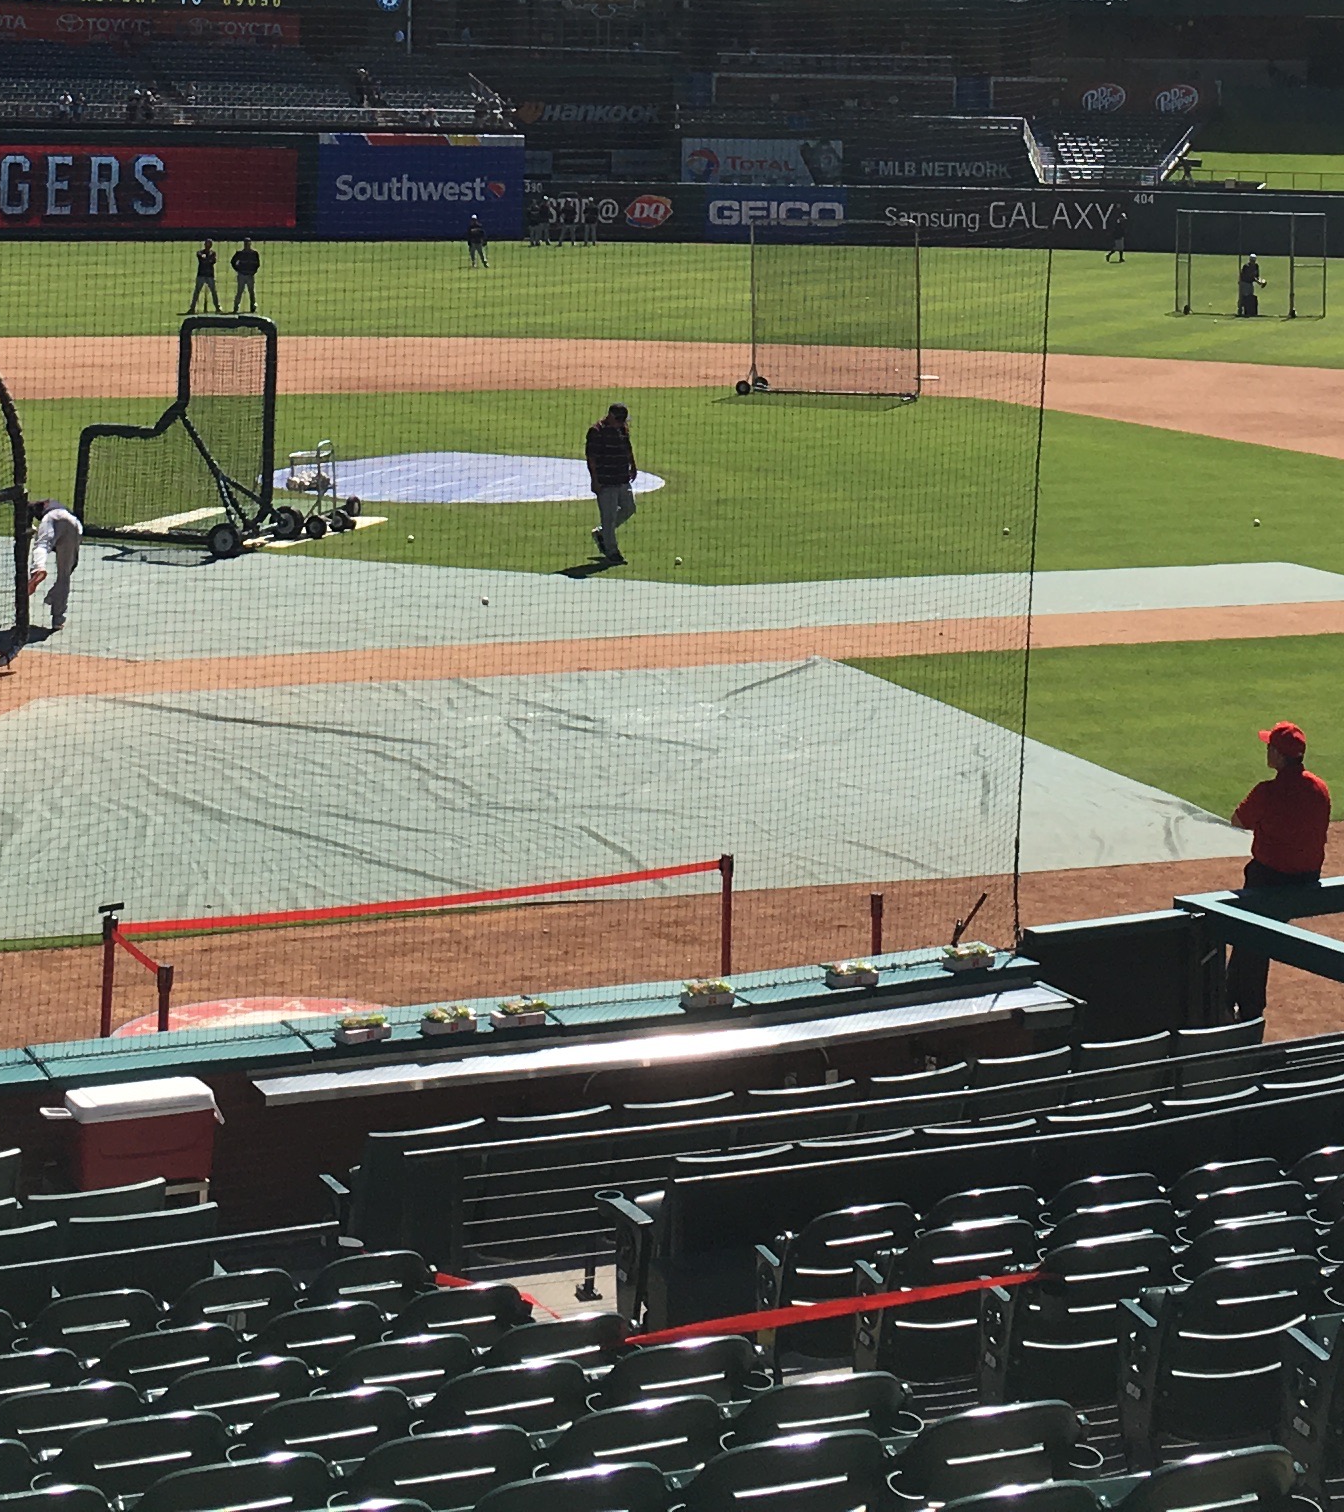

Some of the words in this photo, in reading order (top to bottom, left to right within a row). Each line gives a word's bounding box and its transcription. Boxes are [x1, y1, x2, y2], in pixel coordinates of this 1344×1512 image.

[878, 161, 917, 177] MLB
[921, 161, 1011, 178] NETWORK
[336, 174, 486, 203] Southwest
[1134, 193, 1155, 205] 404
[598, 199, 619, 224] @
[633, 202, 666, 219] DQ
[709, 199, 845, 229] GEICO
[884, 206, 980, 233] Samsung
[988, 201, 1114, 230] GALAXY
